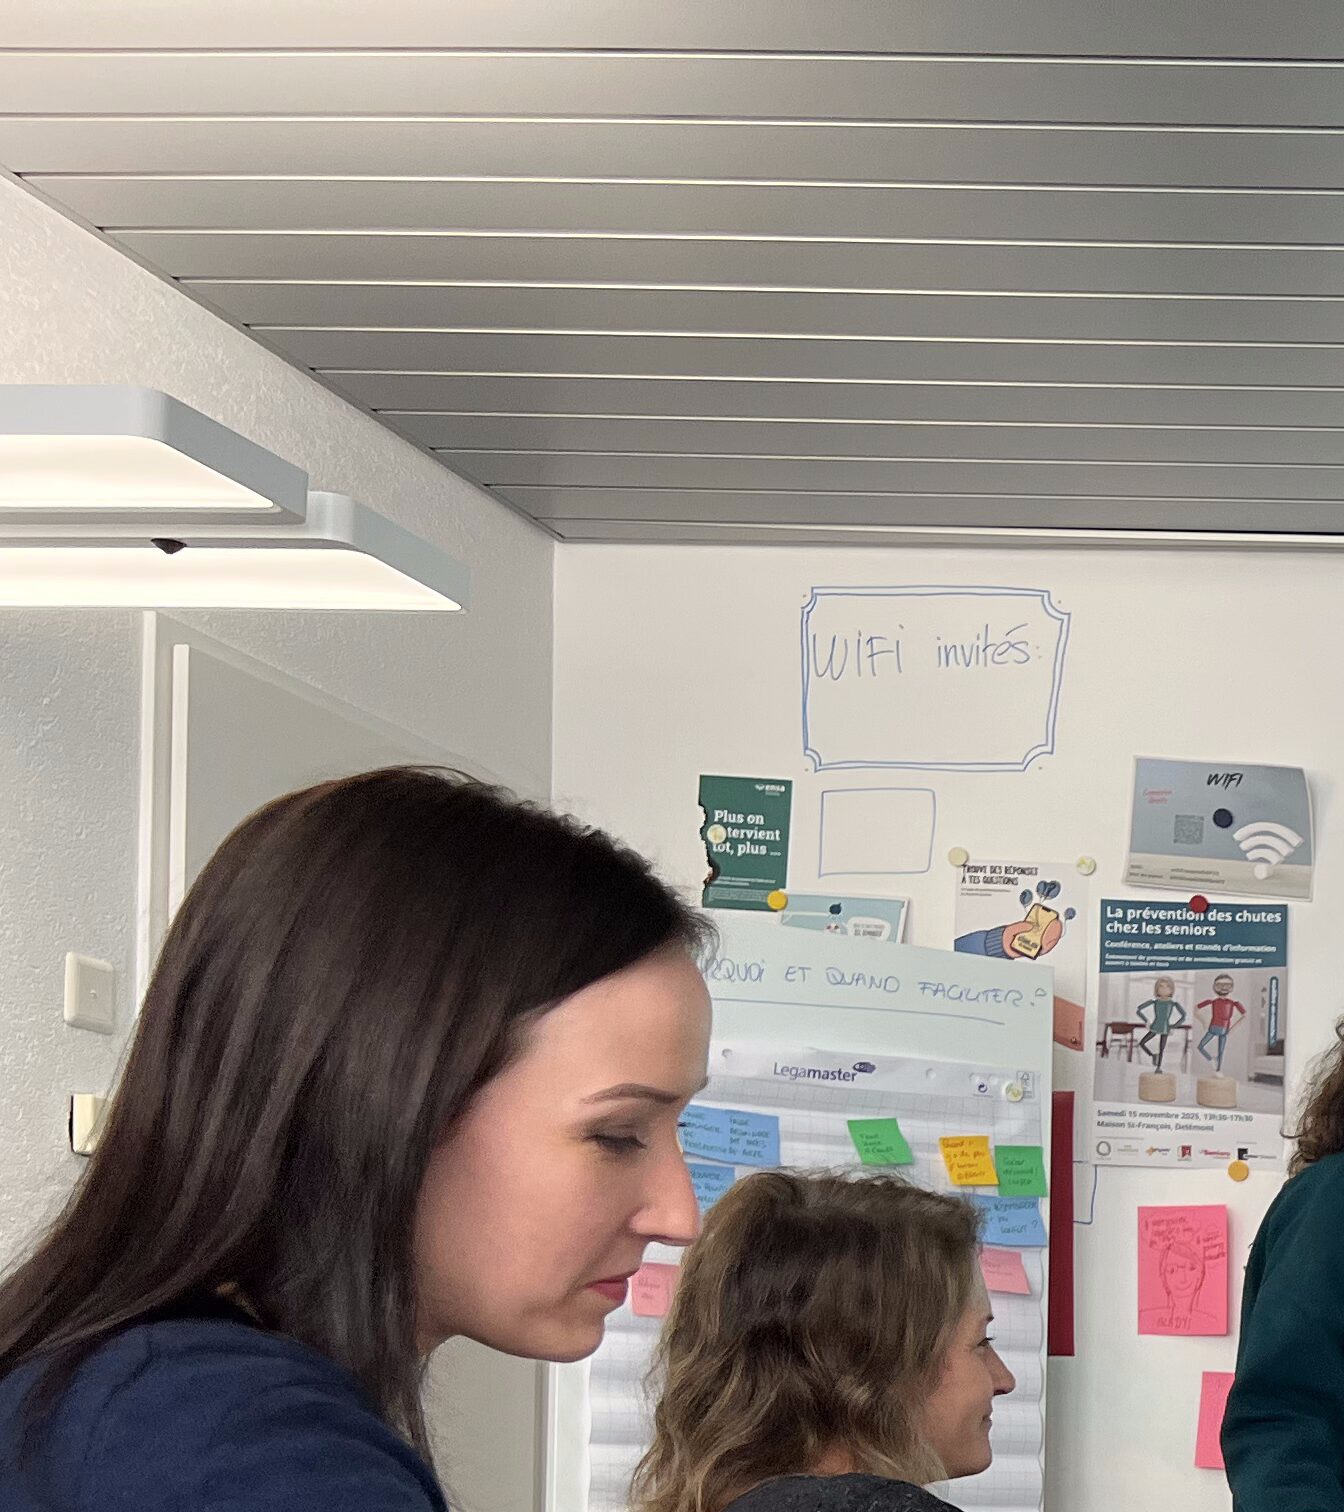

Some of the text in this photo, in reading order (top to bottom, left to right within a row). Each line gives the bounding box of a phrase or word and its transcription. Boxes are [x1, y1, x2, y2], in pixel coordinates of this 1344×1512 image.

[1206, 772, 1244, 791] WIFI
[713, 809, 765, 826] Plus on
[712, 826, 782, 843] tervient
[736, 843, 768, 857] plus
[1106, 905, 1283, 923] La prévention des chutes
[1105, 921, 1217, 937] chez les seniors
[784, 965, 901, 994] ET QUAND
[773, 1061, 858, 1083] Legamaster
[1096, 1108, 1128, 1118] Samedi
[1128, 1110, 1138, 1119] 15
[1138, 1111, 1180, 1120] novembre
[1096, 1120, 1126, 1129] Maison
